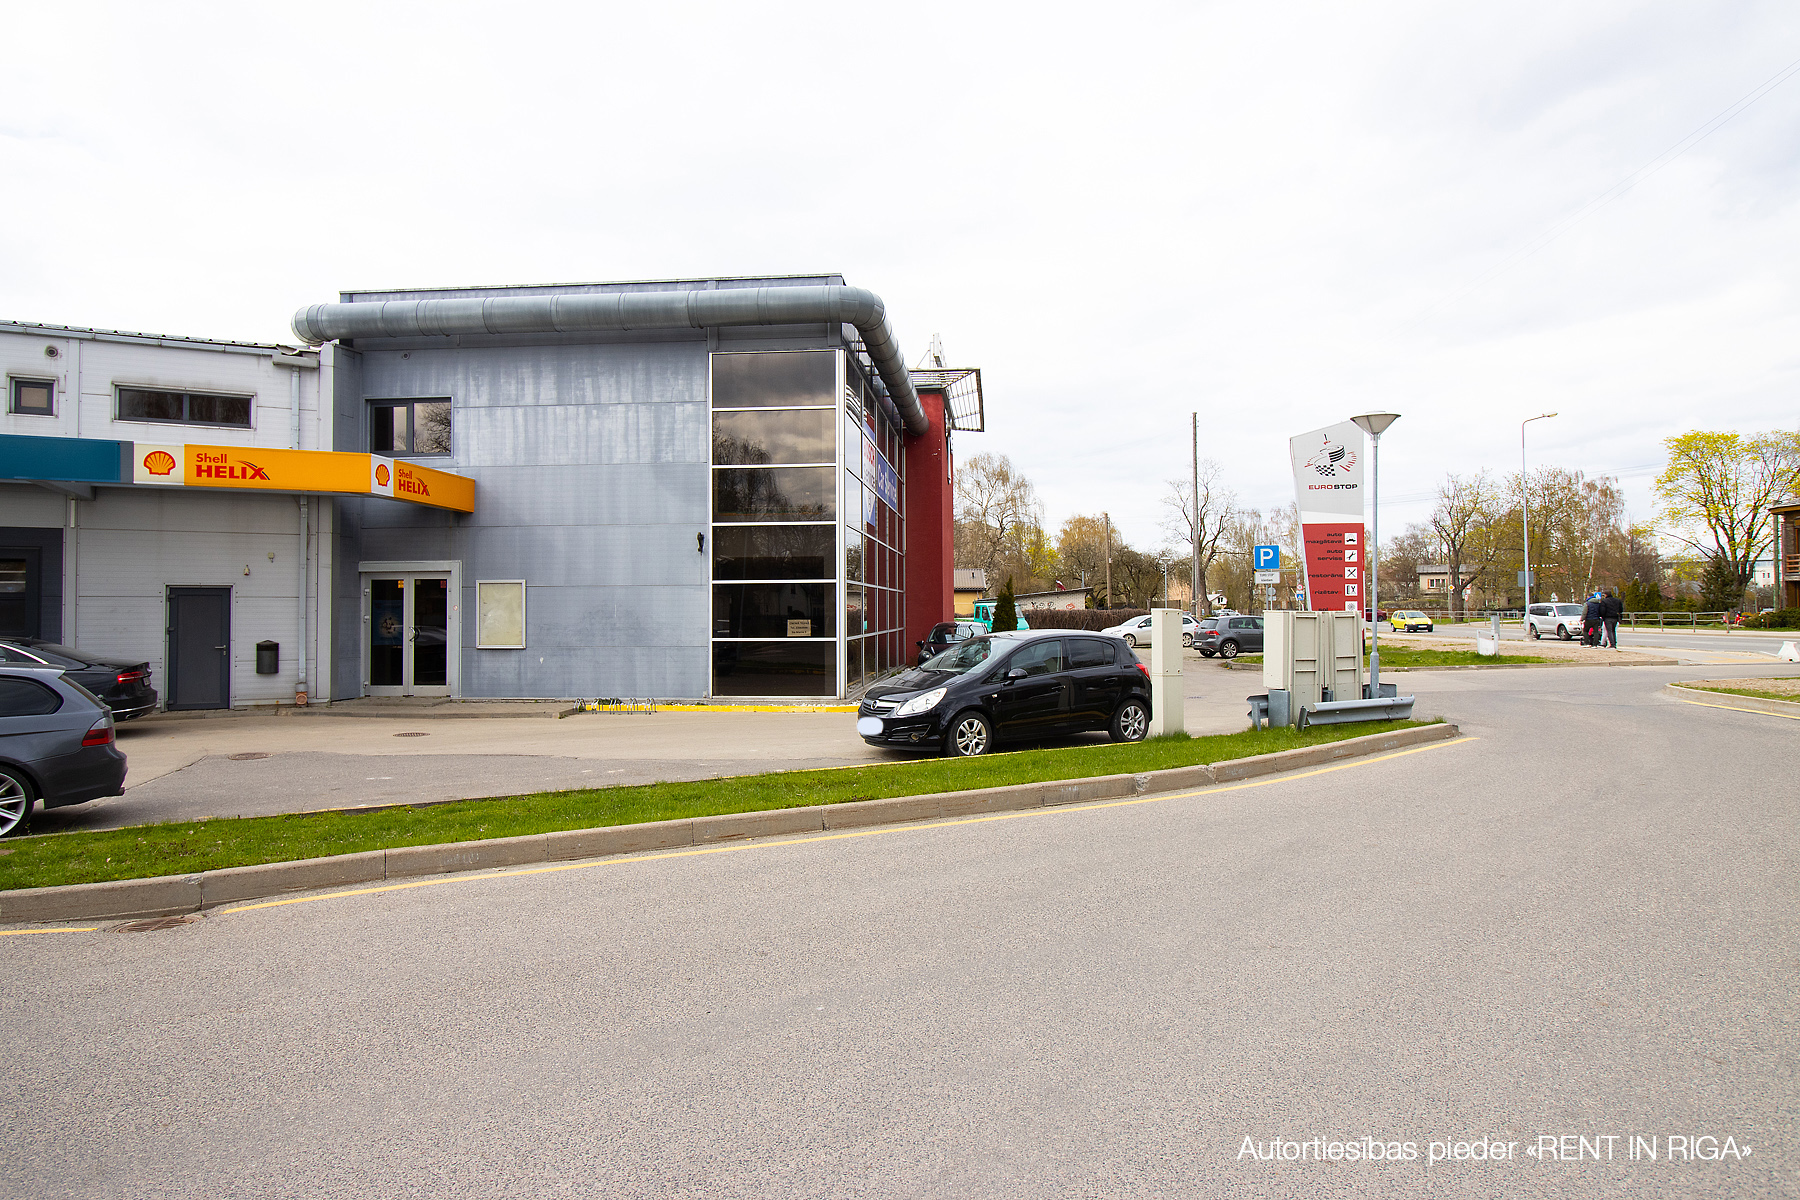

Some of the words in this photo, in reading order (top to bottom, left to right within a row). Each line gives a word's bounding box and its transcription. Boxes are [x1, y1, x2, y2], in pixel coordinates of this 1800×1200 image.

[196, 453, 227, 463] Shell
[195, 460, 270, 480] HELIX
[398, 468, 413, 479] Shell
[398, 477, 430, 497] HELIX
[1260, 548, 1274, 567] P
